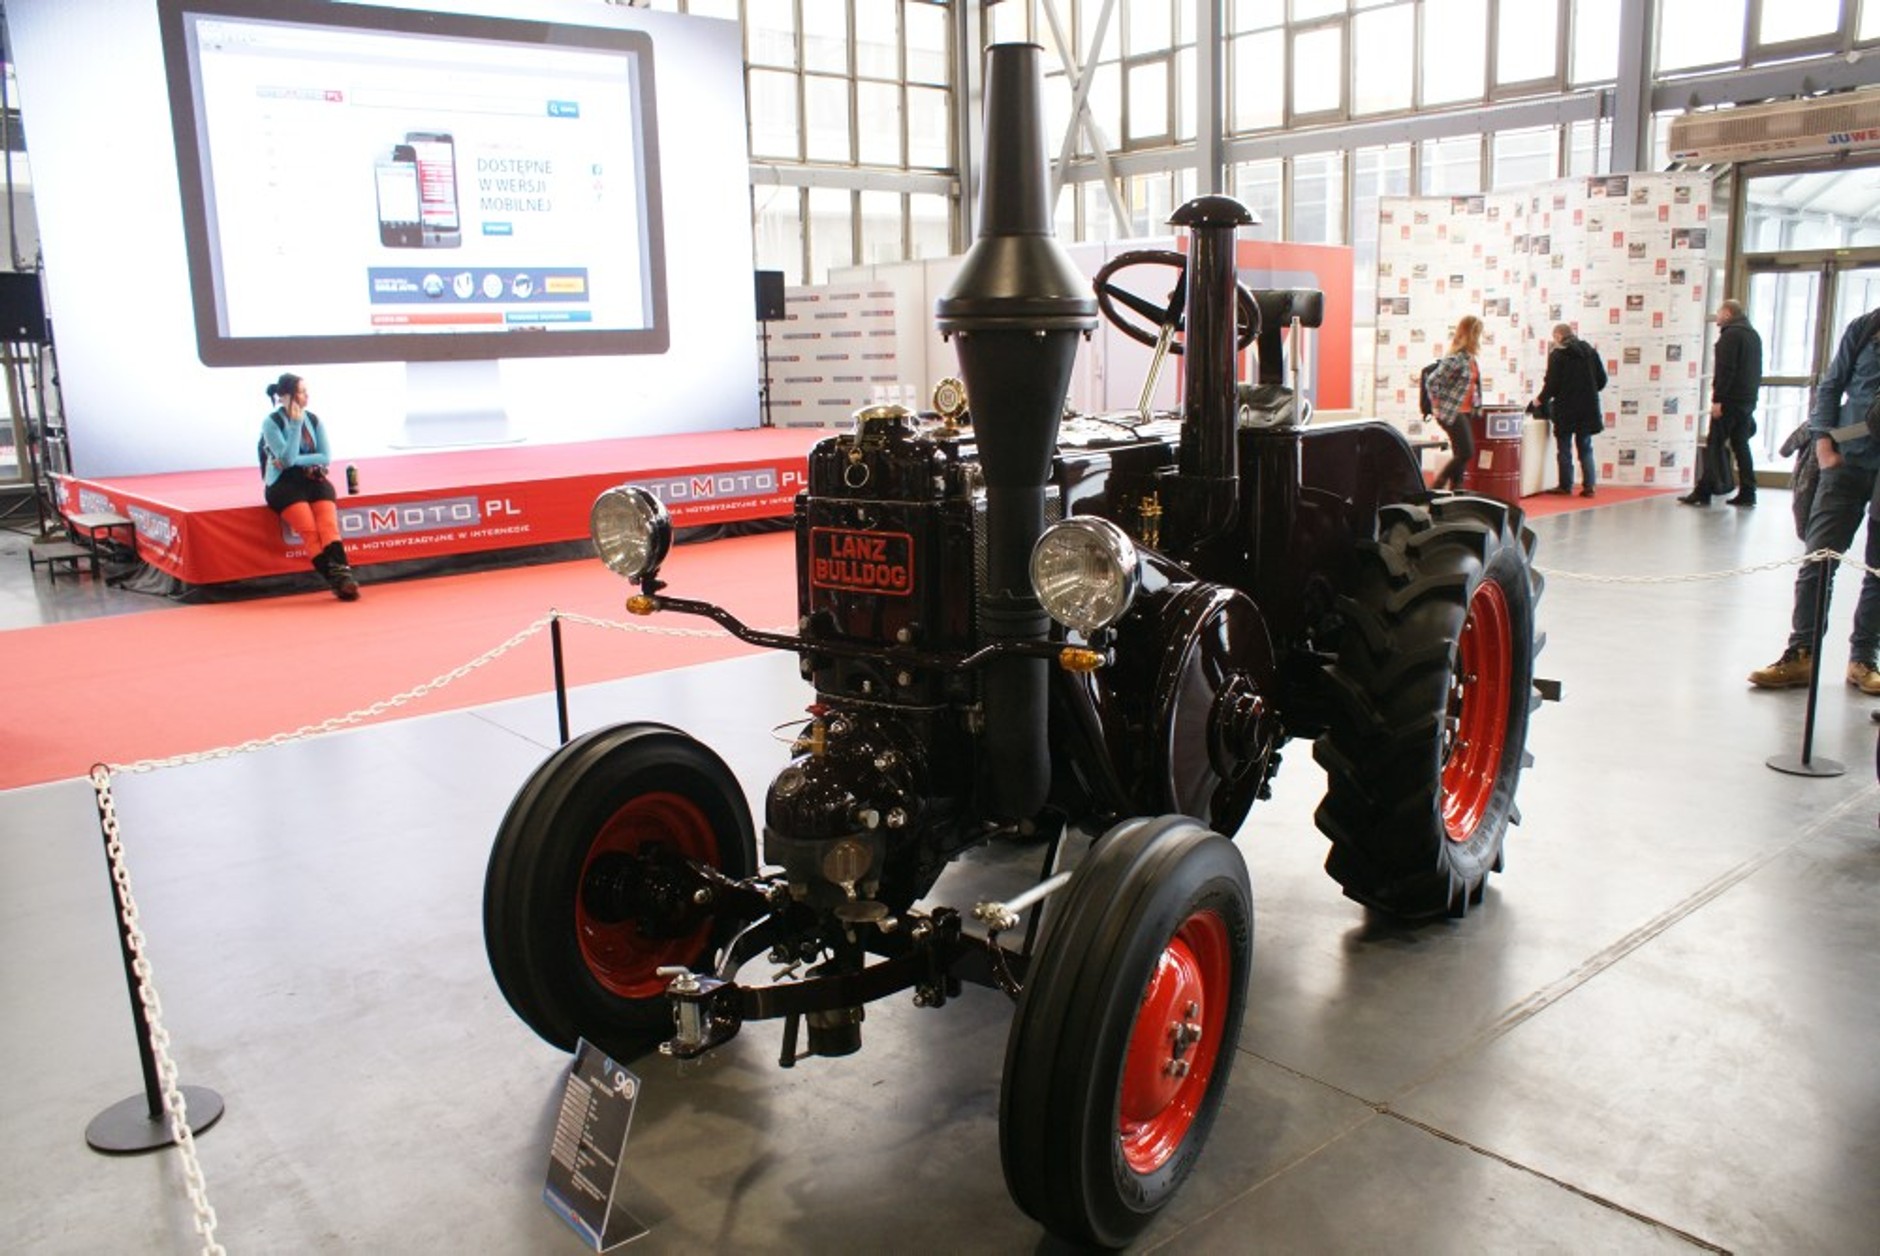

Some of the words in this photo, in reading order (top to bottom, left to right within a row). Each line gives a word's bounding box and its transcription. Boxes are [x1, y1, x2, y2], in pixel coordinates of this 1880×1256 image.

[496, 178, 546, 192] WERSJI
[480, 197, 552, 212] MOBILNEJ
[643, 471, 807, 498] TOMOTO.PL
[831, 533, 887, 561] LANZ
[815, 558, 907, 587] BULLDOG
